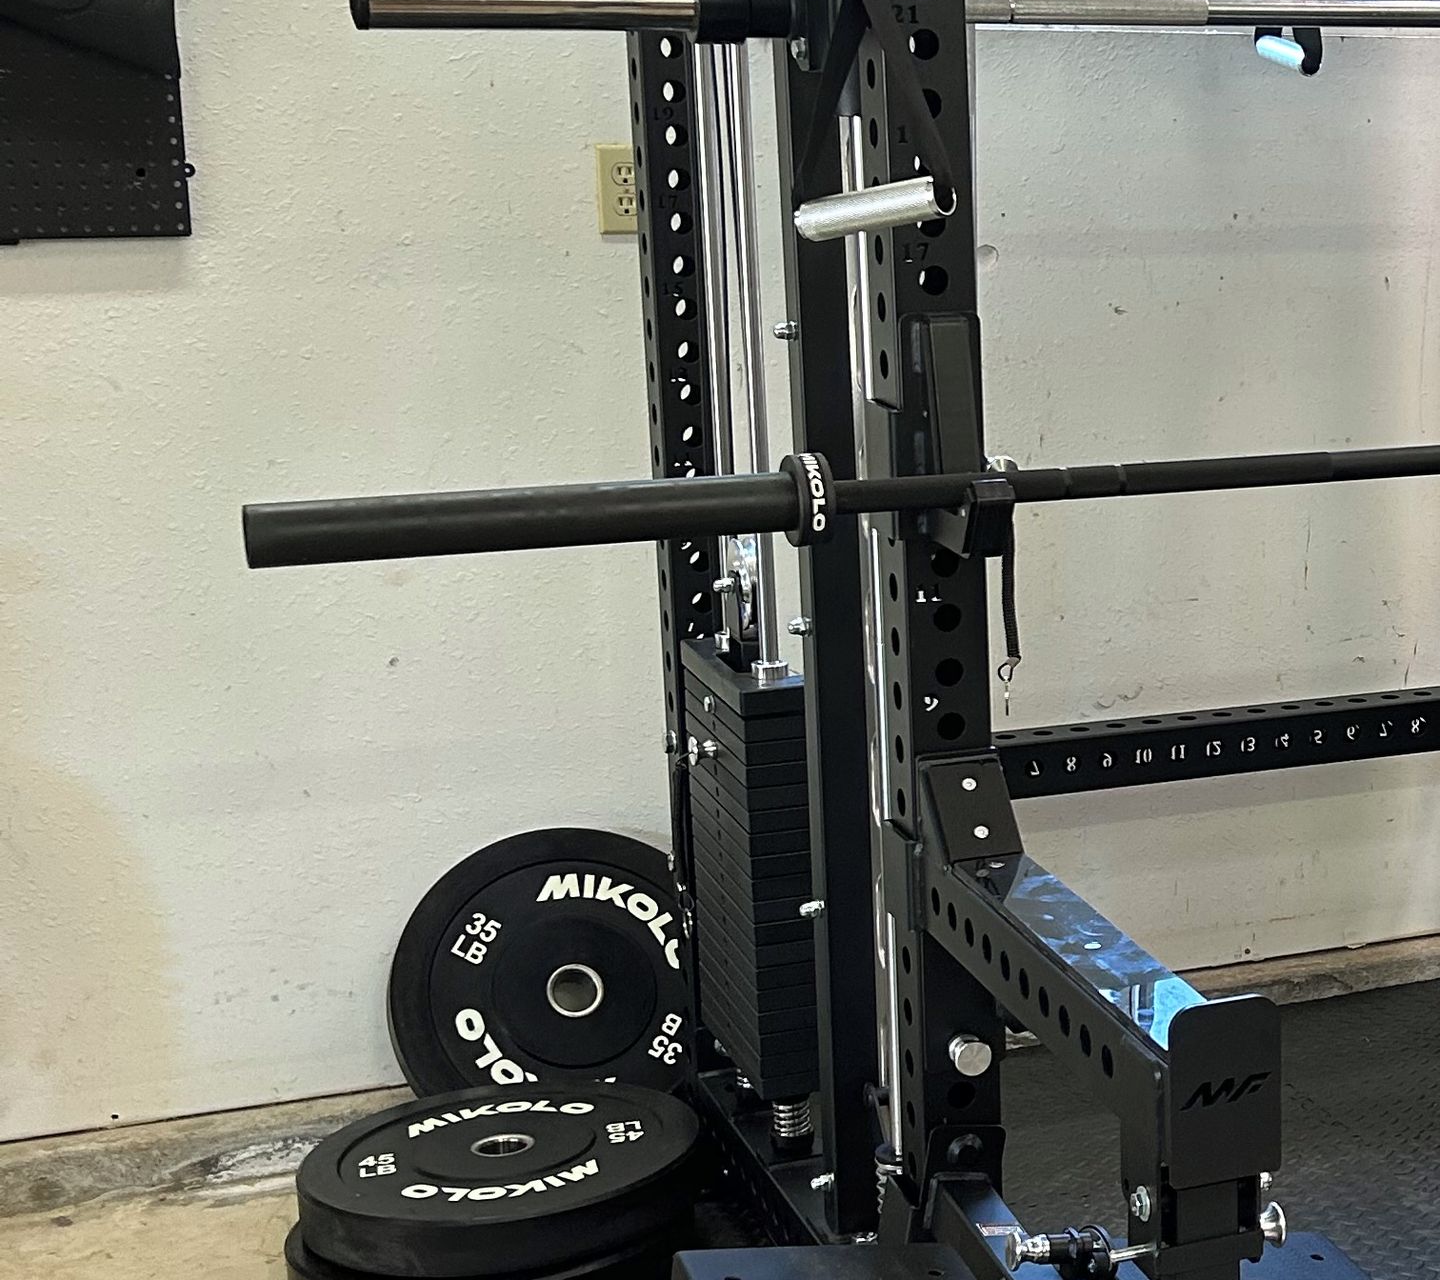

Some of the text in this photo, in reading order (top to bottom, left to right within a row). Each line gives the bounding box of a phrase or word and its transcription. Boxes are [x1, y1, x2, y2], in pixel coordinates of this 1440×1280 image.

[465, 913, 502, 943] 35
[451, 934, 488, 965] LB
[648, 1033, 683, 1065] 35
[408, 1100, 595, 1138] MIKOLO
[605, 1120, 642, 1133] LB
[358, 1153, 395, 1167] 45
[359, 1164, 397, 1178] LB
[401, 1158, 600, 1202] MIKOLO
